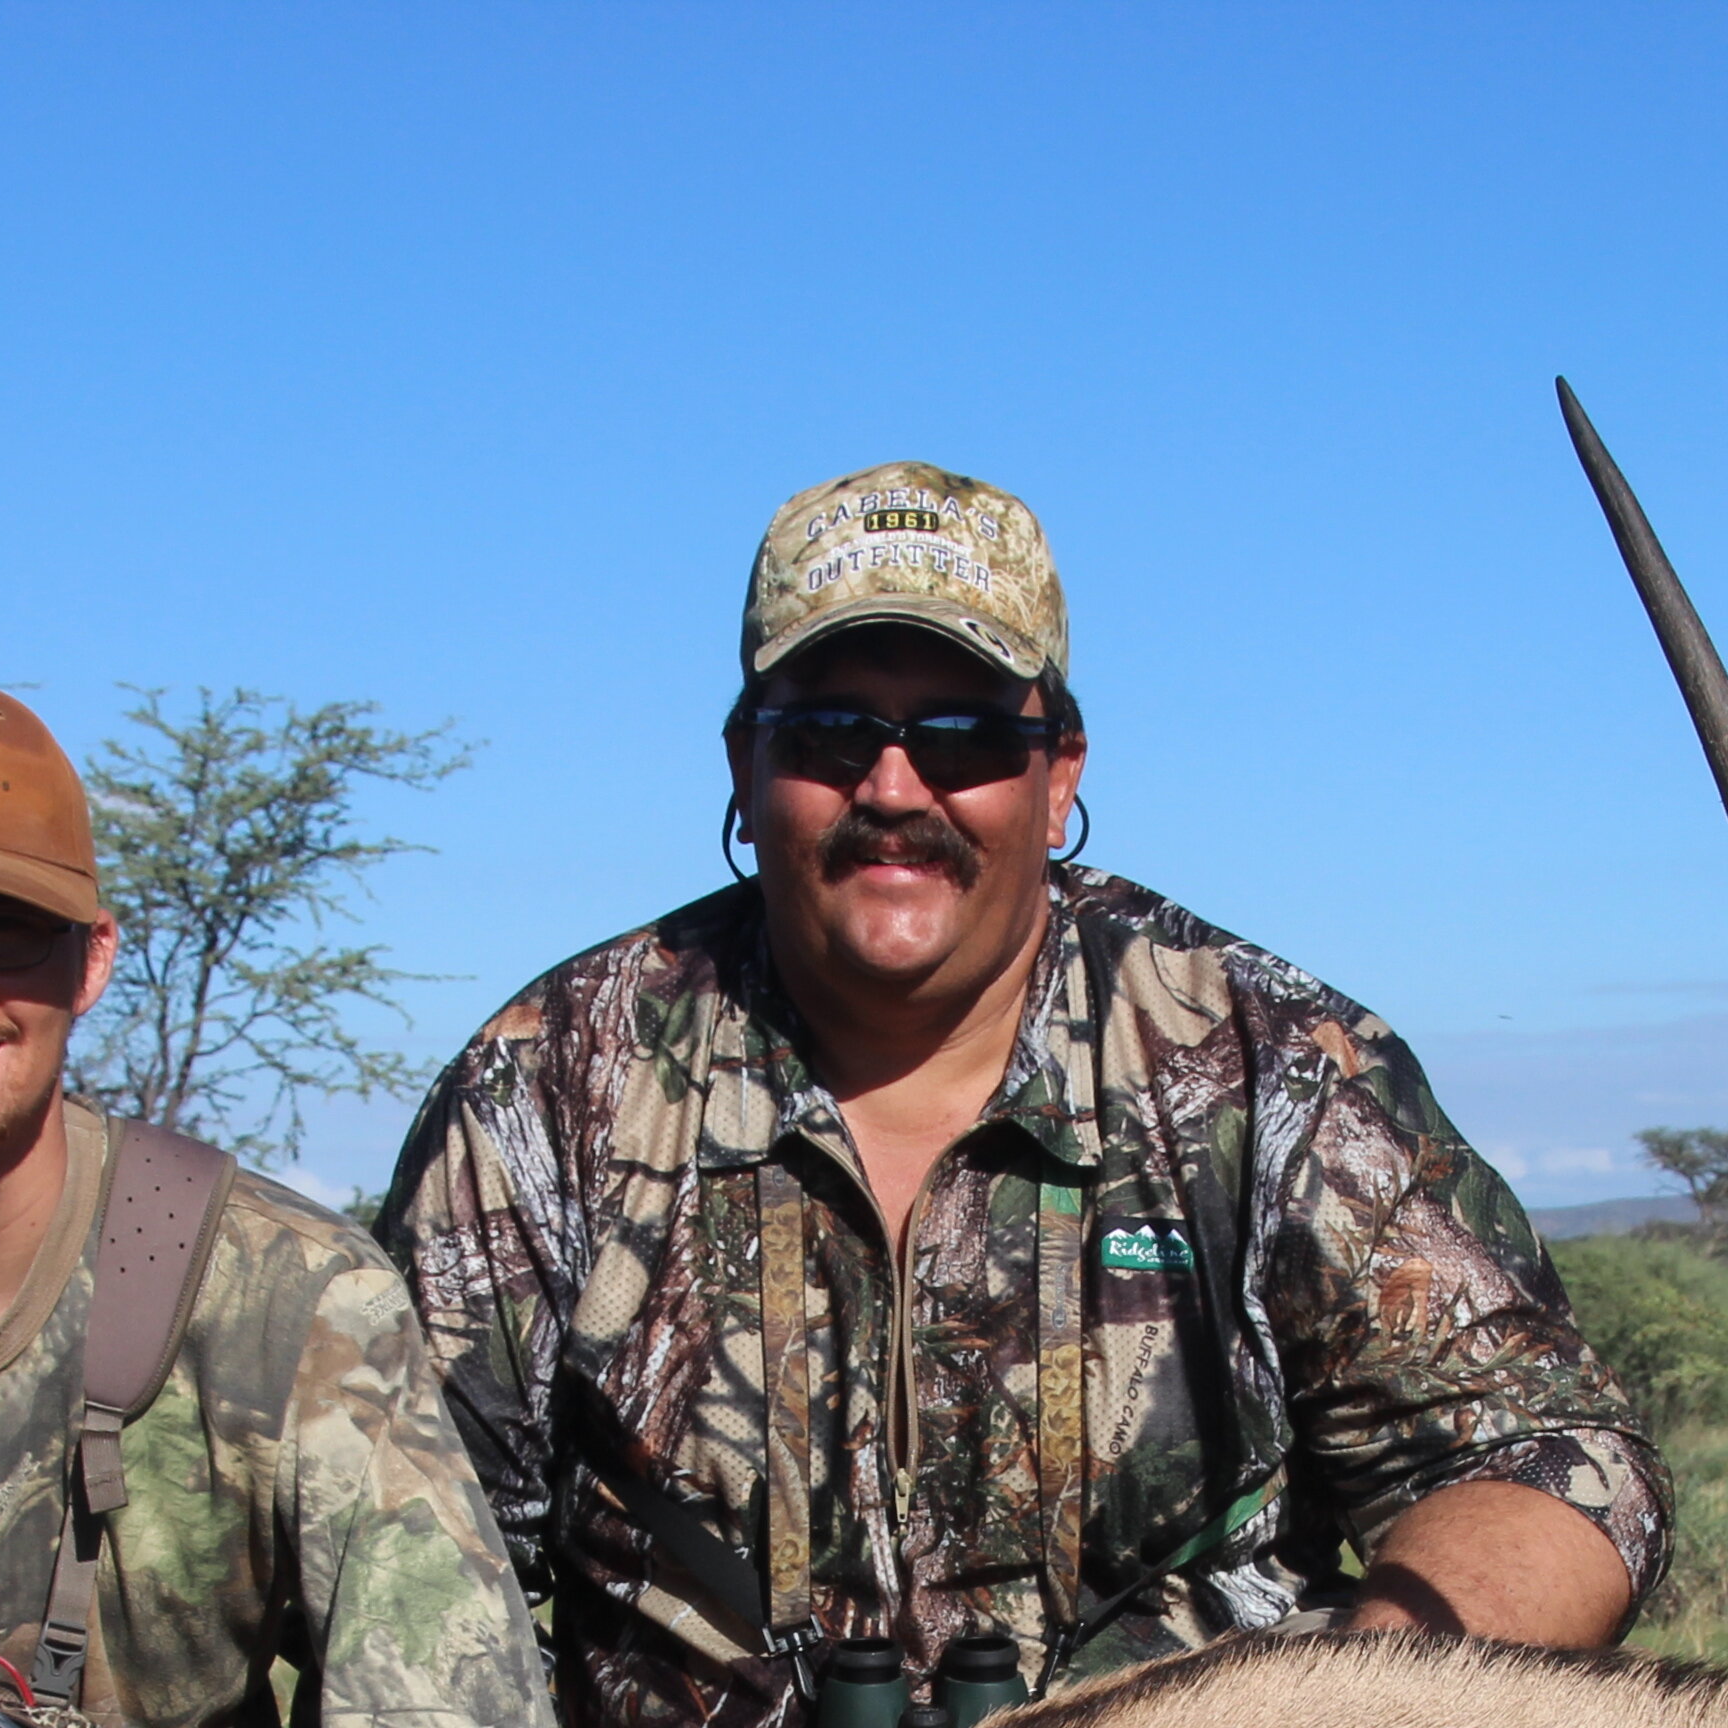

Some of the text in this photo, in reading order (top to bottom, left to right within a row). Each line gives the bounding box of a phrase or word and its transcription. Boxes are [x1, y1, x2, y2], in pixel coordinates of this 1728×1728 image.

[806, 487, 999, 541] CABELA'S
[868, 512, 936, 530] 1961
[807, 543, 992, 593] OUTFITTER
[1109, 1240, 1189, 1263] Ridgeline
[1109, 1324, 1159, 1455] BUFFALO CAMO
